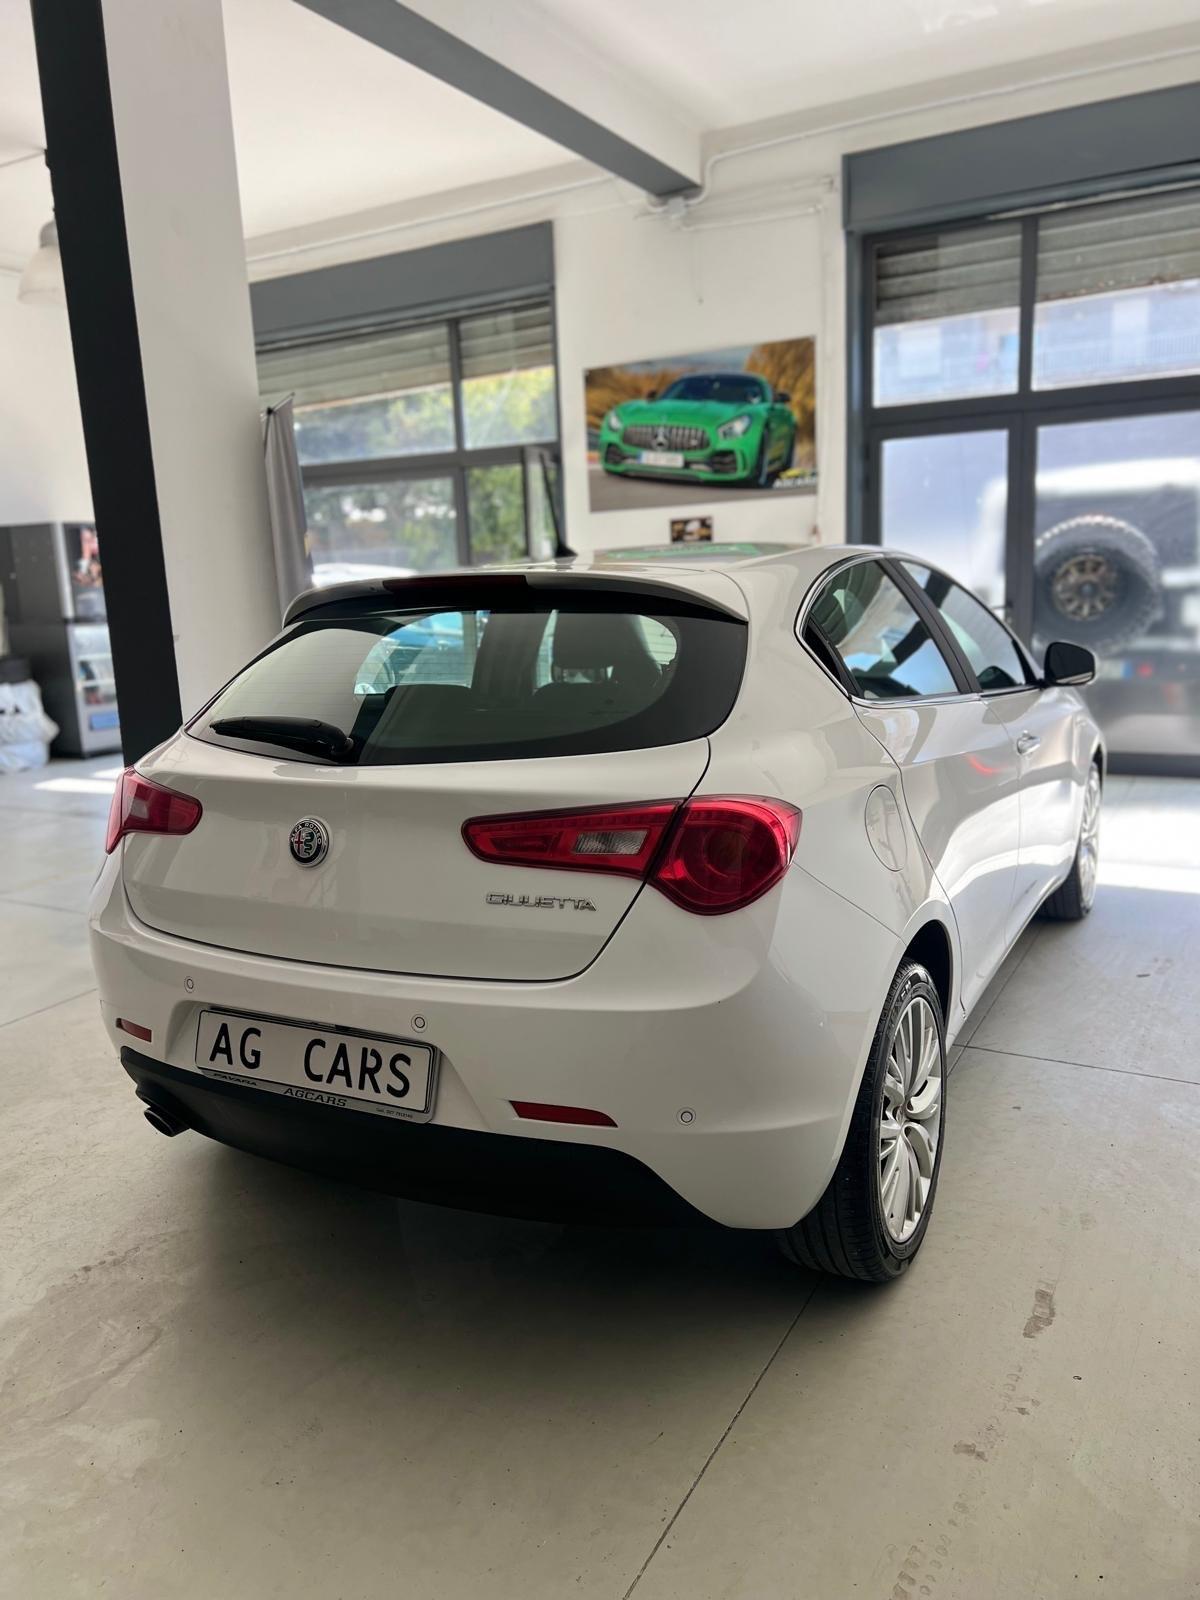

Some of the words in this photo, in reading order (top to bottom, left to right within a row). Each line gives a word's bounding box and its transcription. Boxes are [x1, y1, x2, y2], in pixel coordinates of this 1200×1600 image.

[486, 893, 597, 911] GIULIETTA
[208, 1022, 262, 1070] AG
[303, 1037, 412, 1099] CARS
[283, 1087, 347, 1107] AGCARS
